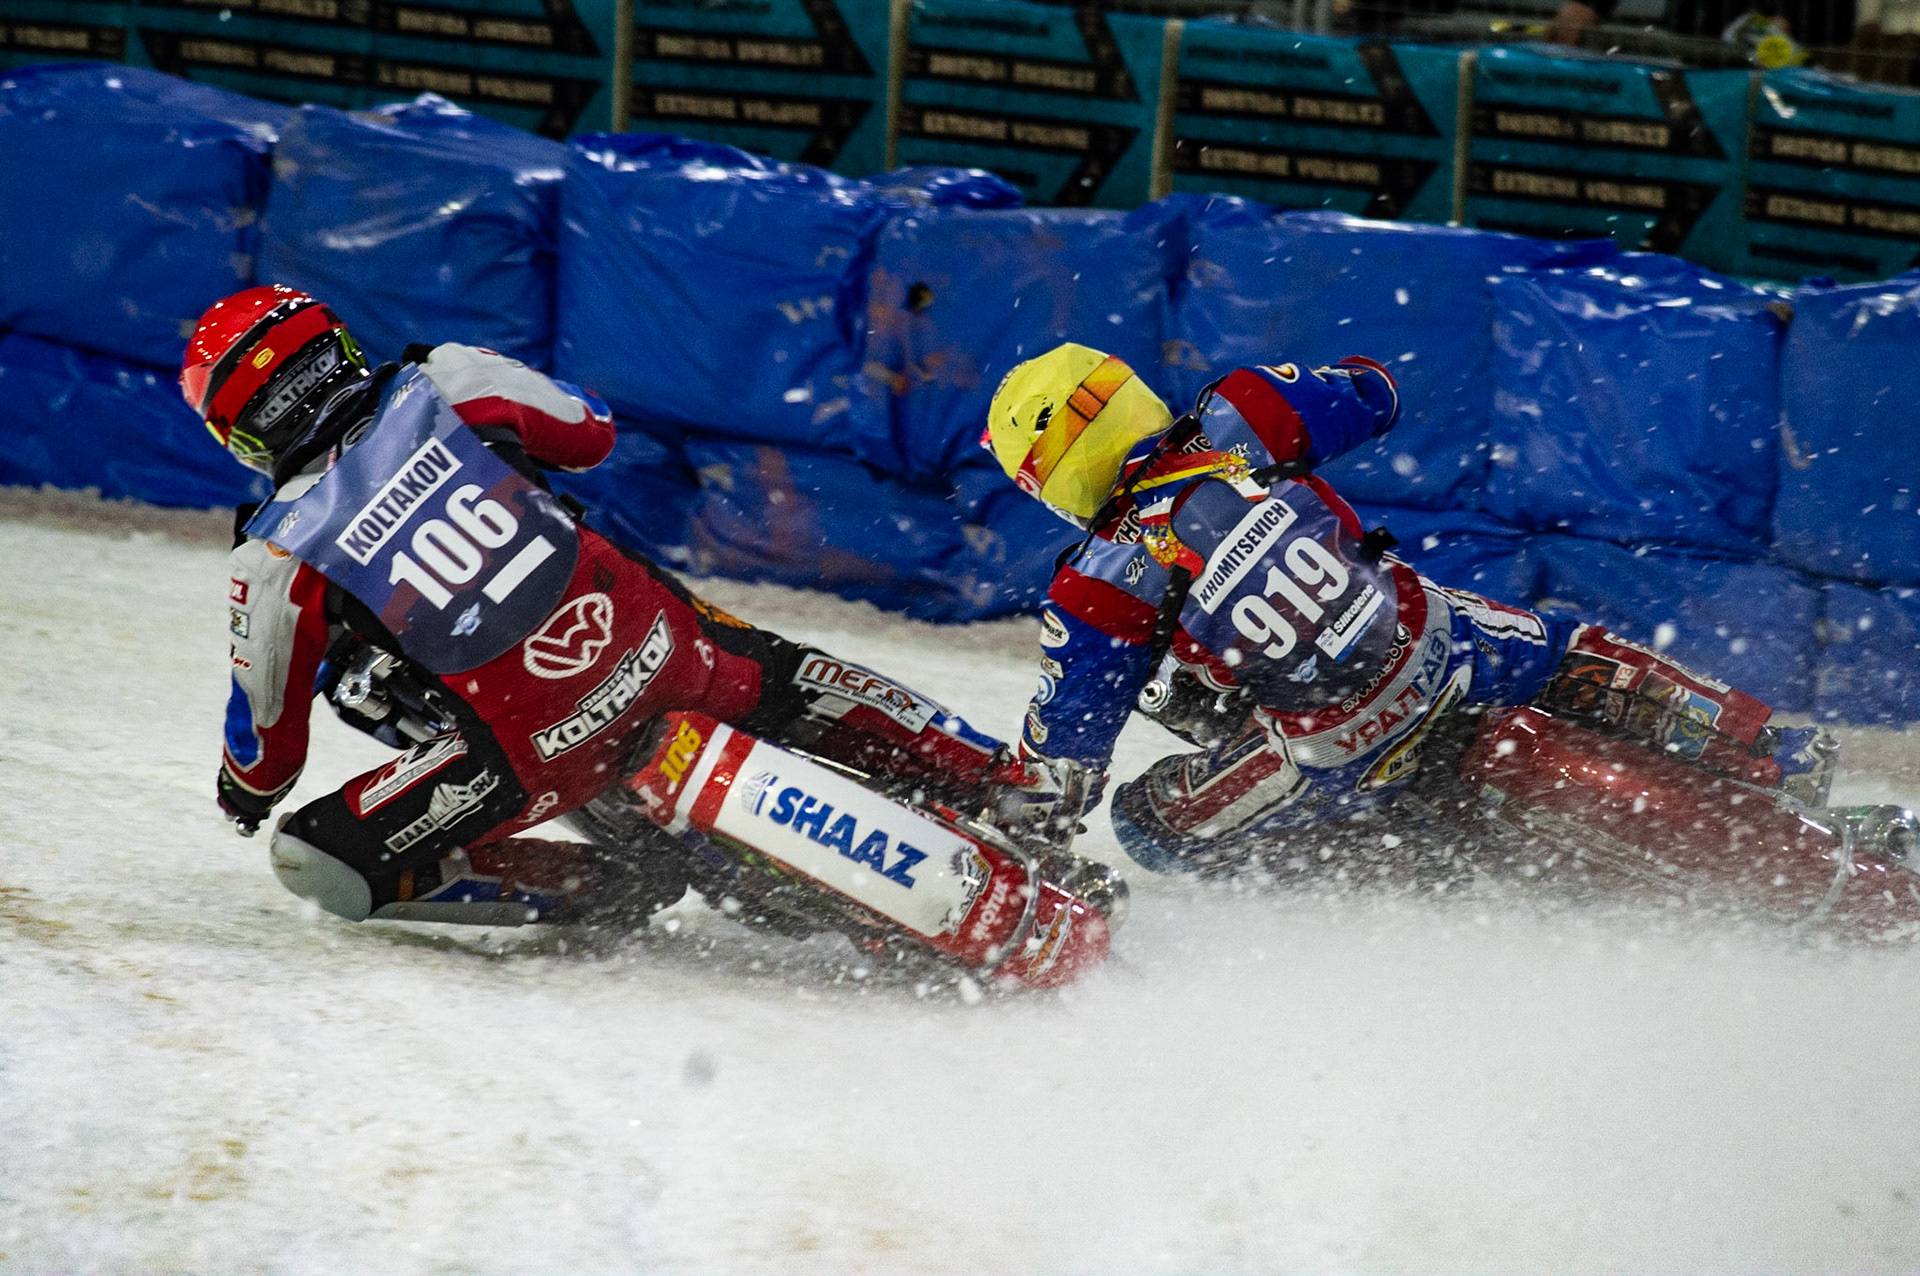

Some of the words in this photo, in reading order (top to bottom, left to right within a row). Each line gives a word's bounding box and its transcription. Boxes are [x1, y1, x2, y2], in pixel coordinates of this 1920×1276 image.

[253, 346, 338, 428] KOLTAKOV
[345, 445, 453, 557] KOLTAKOV
[388, 484, 519, 611] 106
[1200, 502, 1289, 604] KHOMITSEVICH
[1231, 536, 1350, 660] 919
[1333, 583, 1375, 633] Silkolene
[536, 620, 673, 757] KOLTAKOV
[1335, 634, 1447, 756] УРАЛГАЗ
[659, 720, 701, 785] 106
[768, 786, 929, 890] SHAAZ
